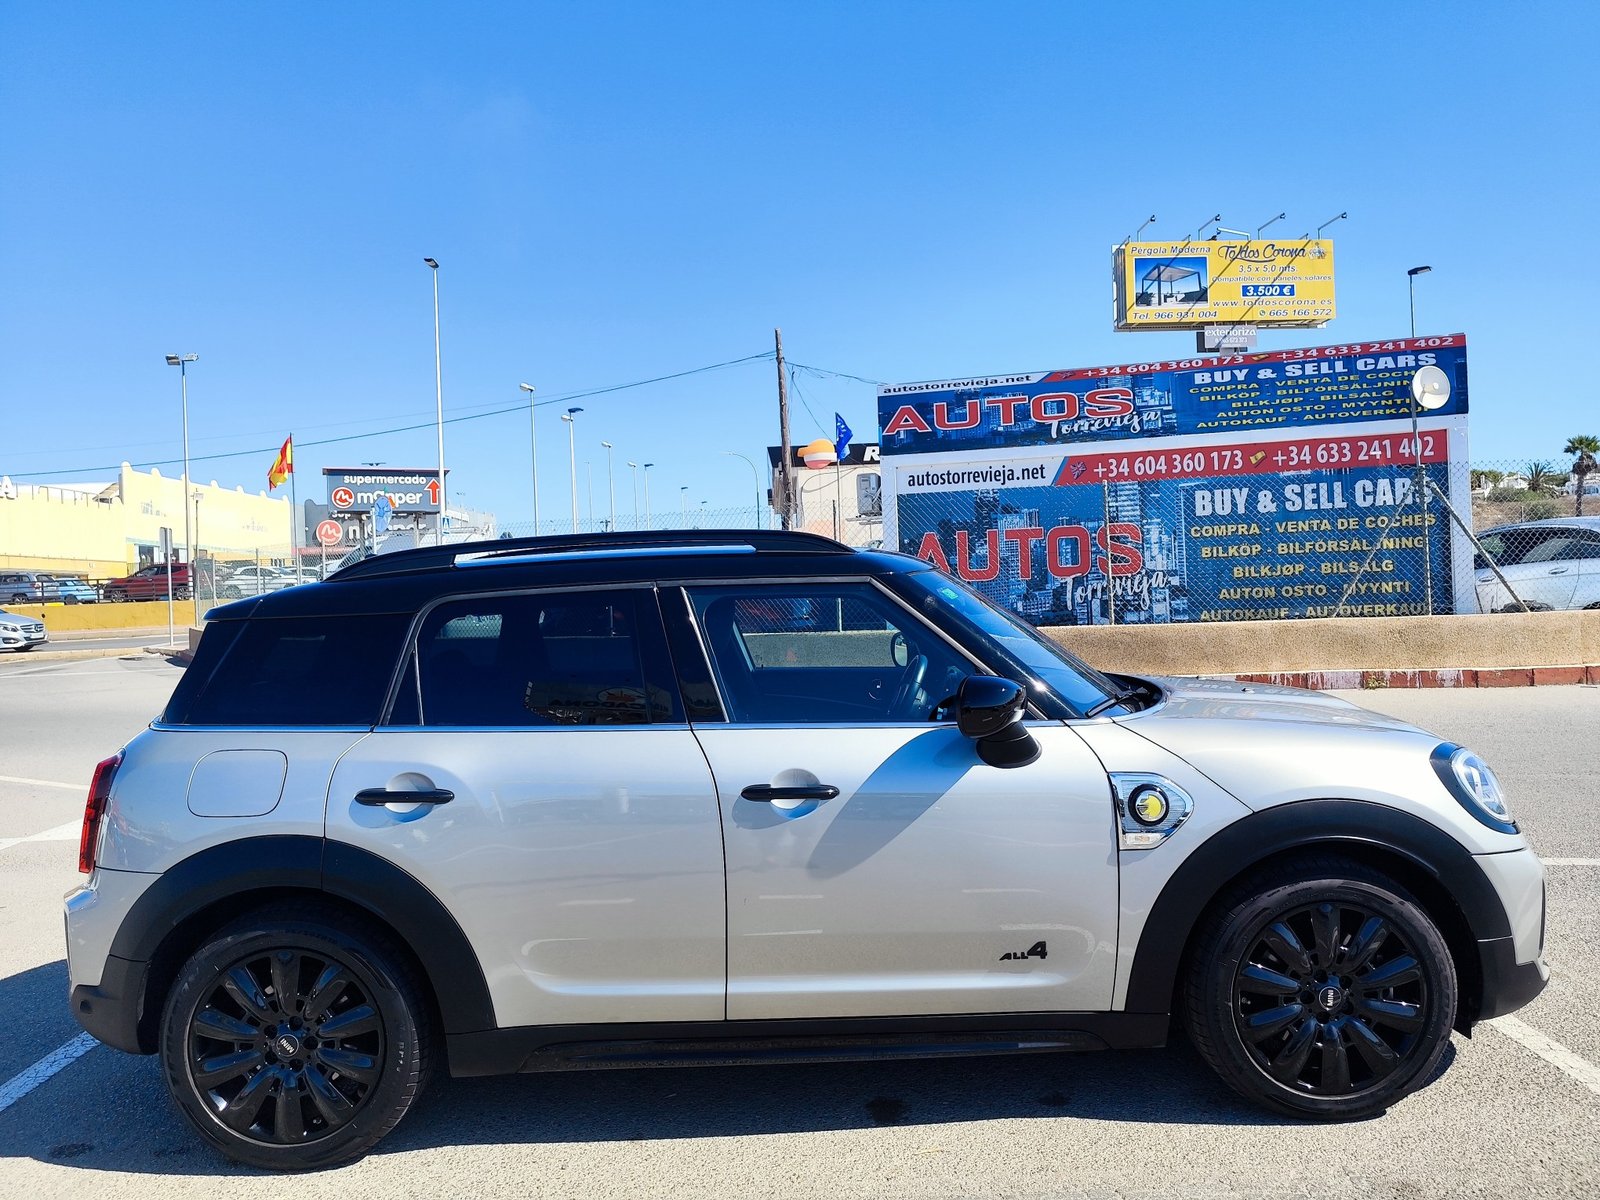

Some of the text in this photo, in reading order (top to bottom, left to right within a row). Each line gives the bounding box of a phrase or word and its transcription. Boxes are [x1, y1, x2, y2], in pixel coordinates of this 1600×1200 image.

[1170, 246, 1211, 254] Moderna
[1218, 243, 1306, 260] Toldos Corona
[1239, 265, 1252, 273] 3,5
[1263, 265, 1276, 273] 5,0
[1246, 285, 1292, 296] 3.500 €
[1213, 299, 1332, 307] www.toldoscorona.es
[1268, 308, 1332, 317] 665 166 572
[1133, 312, 1150, 320] Tel.
[1154, 311, 1173, 320] 966
[1198, 310, 1218, 319] 004
[1205, 327, 1257, 337] exterioriza
[1276, 336, 1455, 361] +34 633 241 402
[1083, 354, 1245, 378] +34 604 360 173
[1194, 352, 1437, 385] BUY & SELL CARS
[883, 375, 1031, 395] autostorrevieja.net
[1189, 382, 1259, 394] COMPRA
[1275, 376, 1332, 387] VENTA
[1337, 374, 1360, 382] DE
[1365, 370, 1416, 380] COCH
[1200, 389, 1259, 402] BILKÖP
[1277, 378, 1413, 396] BILFÖRSÄLJNIN
[1217, 406, 1274, 418] AUTON
[1280, 403, 1326, 413] OSTO
[1342, 397, 1410, 410] MYYNTI
[1231, 396, 1304, 408] BILKJØP
[1320, 390, 1394, 402] BILSALG
[882, 387, 1134, 436] AUTOS
[1045, 408, 1161, 439] Torrevieja
[1197, 415, 1287, 430] AUTOKAUF
[1272, 436, 1435, 467] +34 633 241 402
[1093, 449, 1244, 479] +34 604 360 173
[343, 475, 427, 486] supermercado
[908, 463, 1046, 487] autostorrevieja.net
[1194, 487, 1250, 517] BUY
[1257, 489, 1278, 514] &
[1285, 481, 1348, 511] SELL
[1190, 524, 1261, 538] COMPRA
[1275, 519, 1332, 534] VENTA
[1337, 518, 1360, 530] DE
[1365, 513, 1436, 528] COCHES
[916, 522, 1144, 582] AUTOS
[1201, 541, 1261, 559] BILKÖP
[1233, 564, 1305, 579] BILKJØP
[1321, 559, 1395, 575] BILSALG
[1062, 570, 1168, 611] Torrevieja
[1219, 586, 1276, 600] AUTON
[1281, 584, 1327, 598] OSTO
[1200, 607, 1289, 622] AUTOKAUF
[998, 940, 1048, 961] ALL4
[1326, 989, 1334, 1007] MINI
[279, 1038, 295, 1054] MINI
